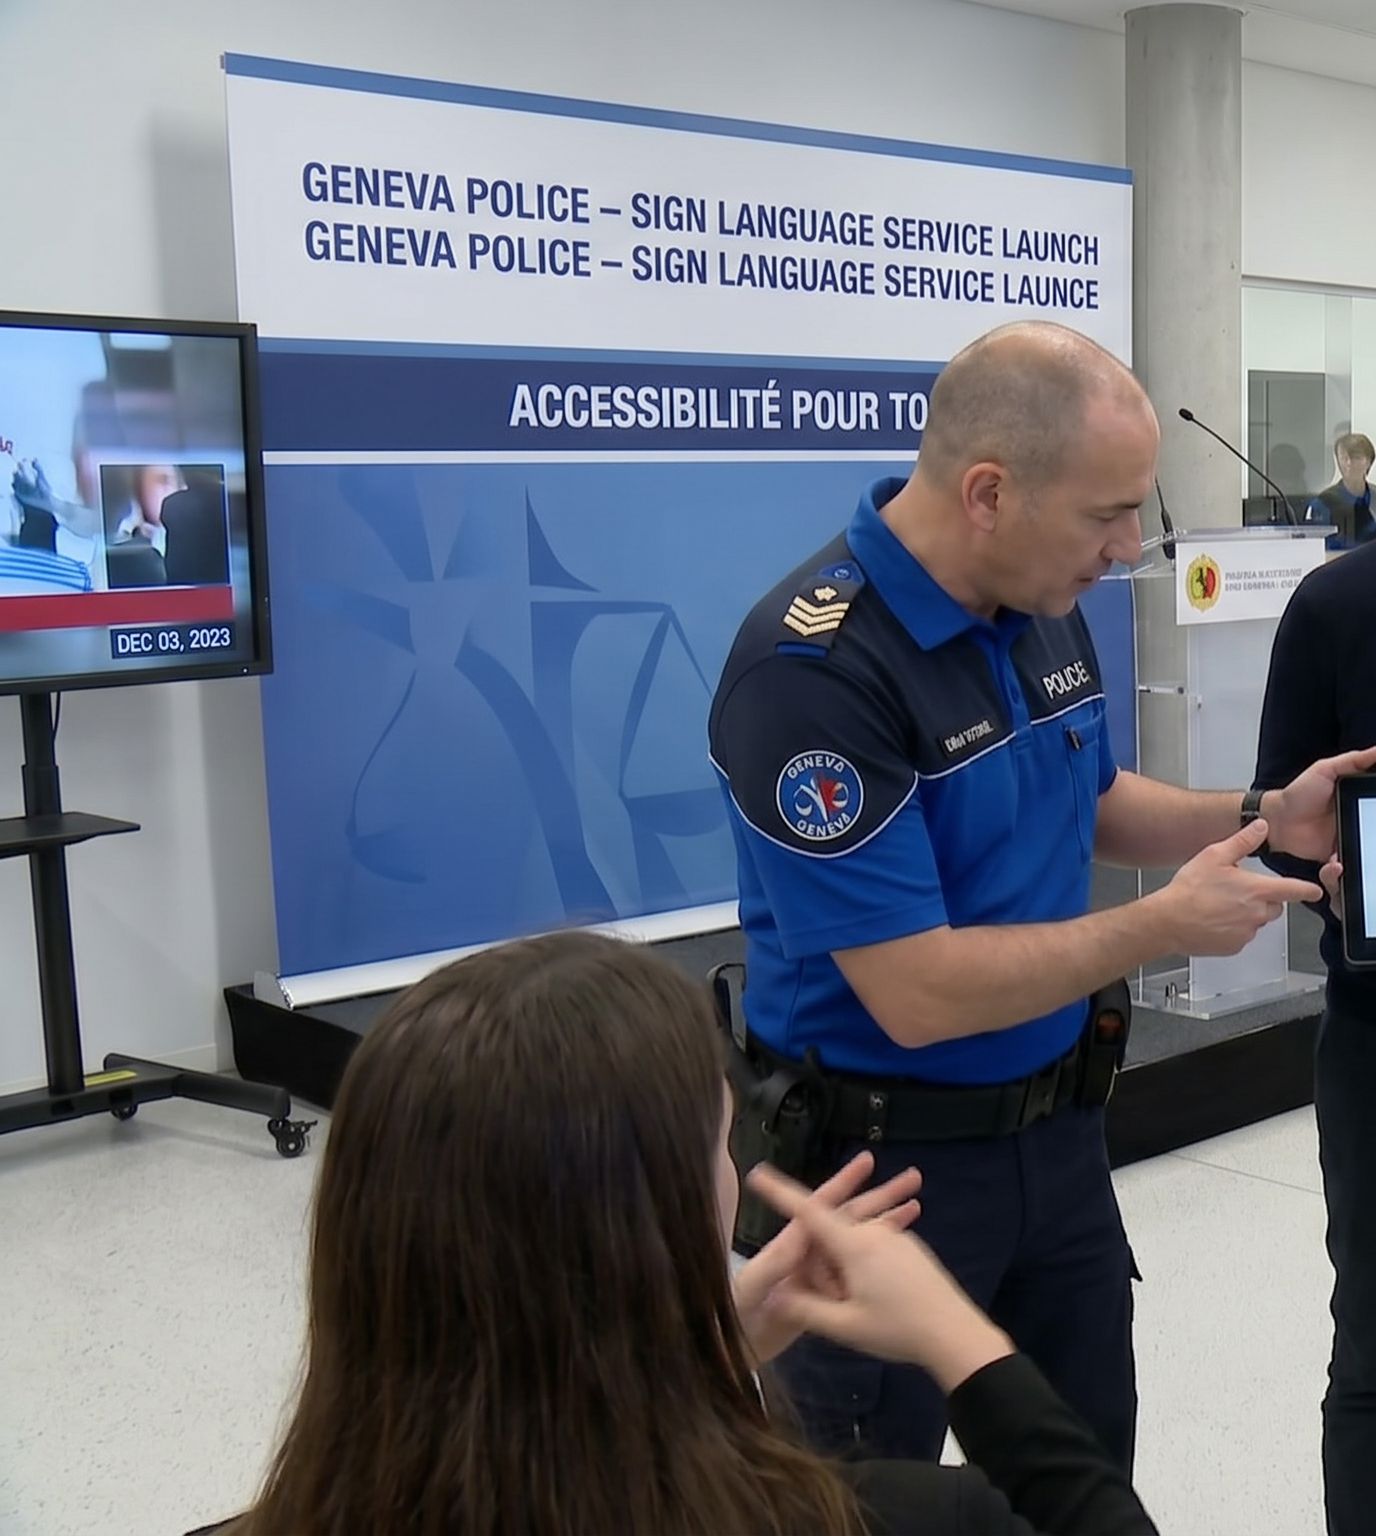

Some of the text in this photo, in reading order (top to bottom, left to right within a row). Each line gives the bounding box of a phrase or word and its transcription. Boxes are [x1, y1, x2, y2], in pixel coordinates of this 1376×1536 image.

[302, 162, 455, 212] GENEVA
[466, 177, 590, 224] POLICE
[631, 193, 706, 233] SIGN
[719, 200, 874, 247] LANGUAGE
[883, 216, 993, 256] SERVICE
[1002, 227, 1098, 265] LAUNCH
[305, 220, 457, 269] GENEVA
[468, 233, 591, 277] POLICE
[632, 245, 707, 284] SIGN
[719, 252, 875, 295] LANGUAGE
[884, 264, 994, 303] SERVICE
[1003, 273, 1098, 309] LAUNCE
[509, 379, 929, 430] ACCESSIBILITÉ POUR TO
[117, 628, 231, 653] DEC 03, 2023
